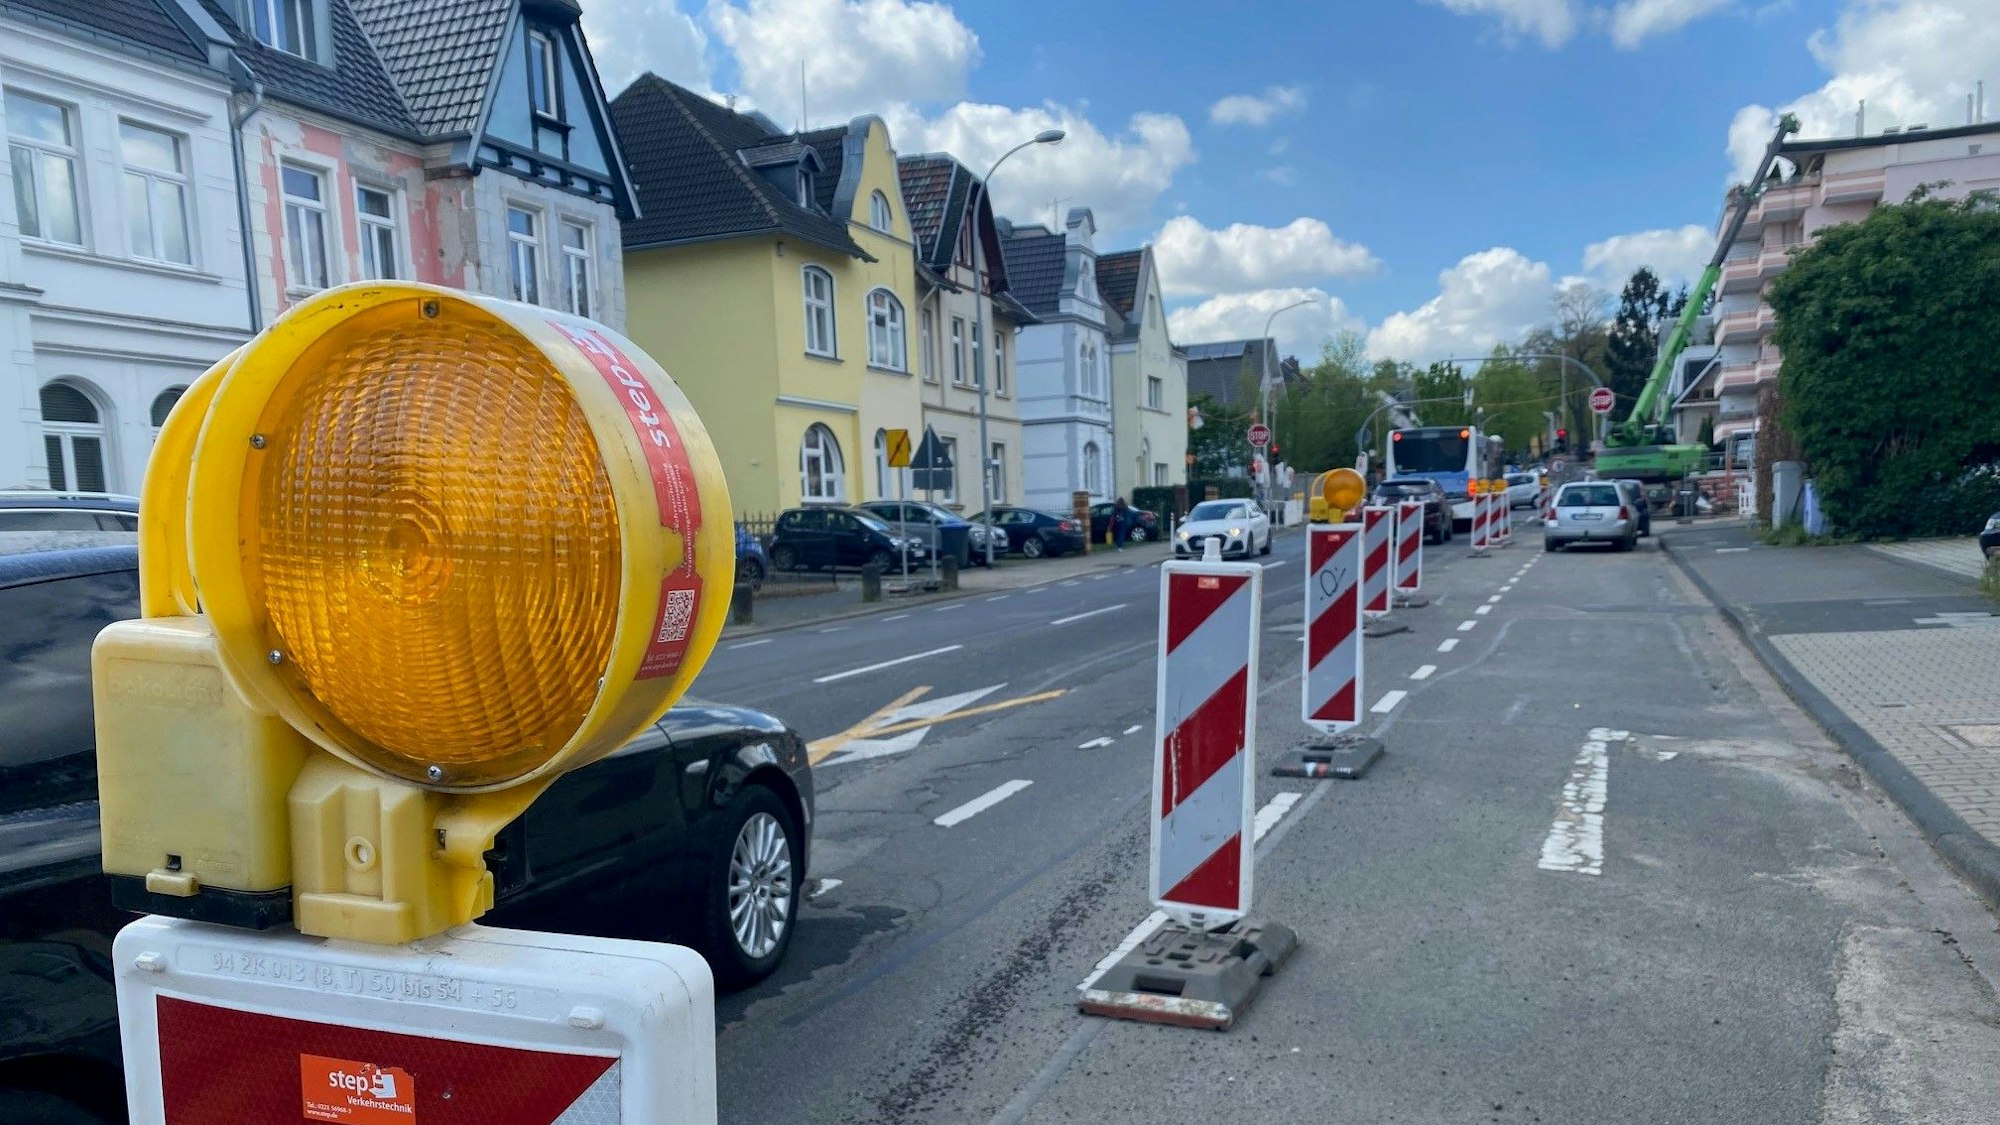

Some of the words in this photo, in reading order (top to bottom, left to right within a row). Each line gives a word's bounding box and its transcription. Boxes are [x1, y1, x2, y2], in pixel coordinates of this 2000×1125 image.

[610, 367, 671, 449] step
[1250, 430, 1269, 440] STOP
[212, 952, 235, 973] 94
[240, 952, 266, 977] 2K
[371, 974, 396, 993] 50
[403, 977, 432, 999] bis
[437, 978, 463, 1002] 54
[471, 987, 483, 1001] +
[488, 989, 518, 1009] 56
[328, 1070, 369, 1096] step
[346, 1094, 413, 1114] Verkehrstechnik
